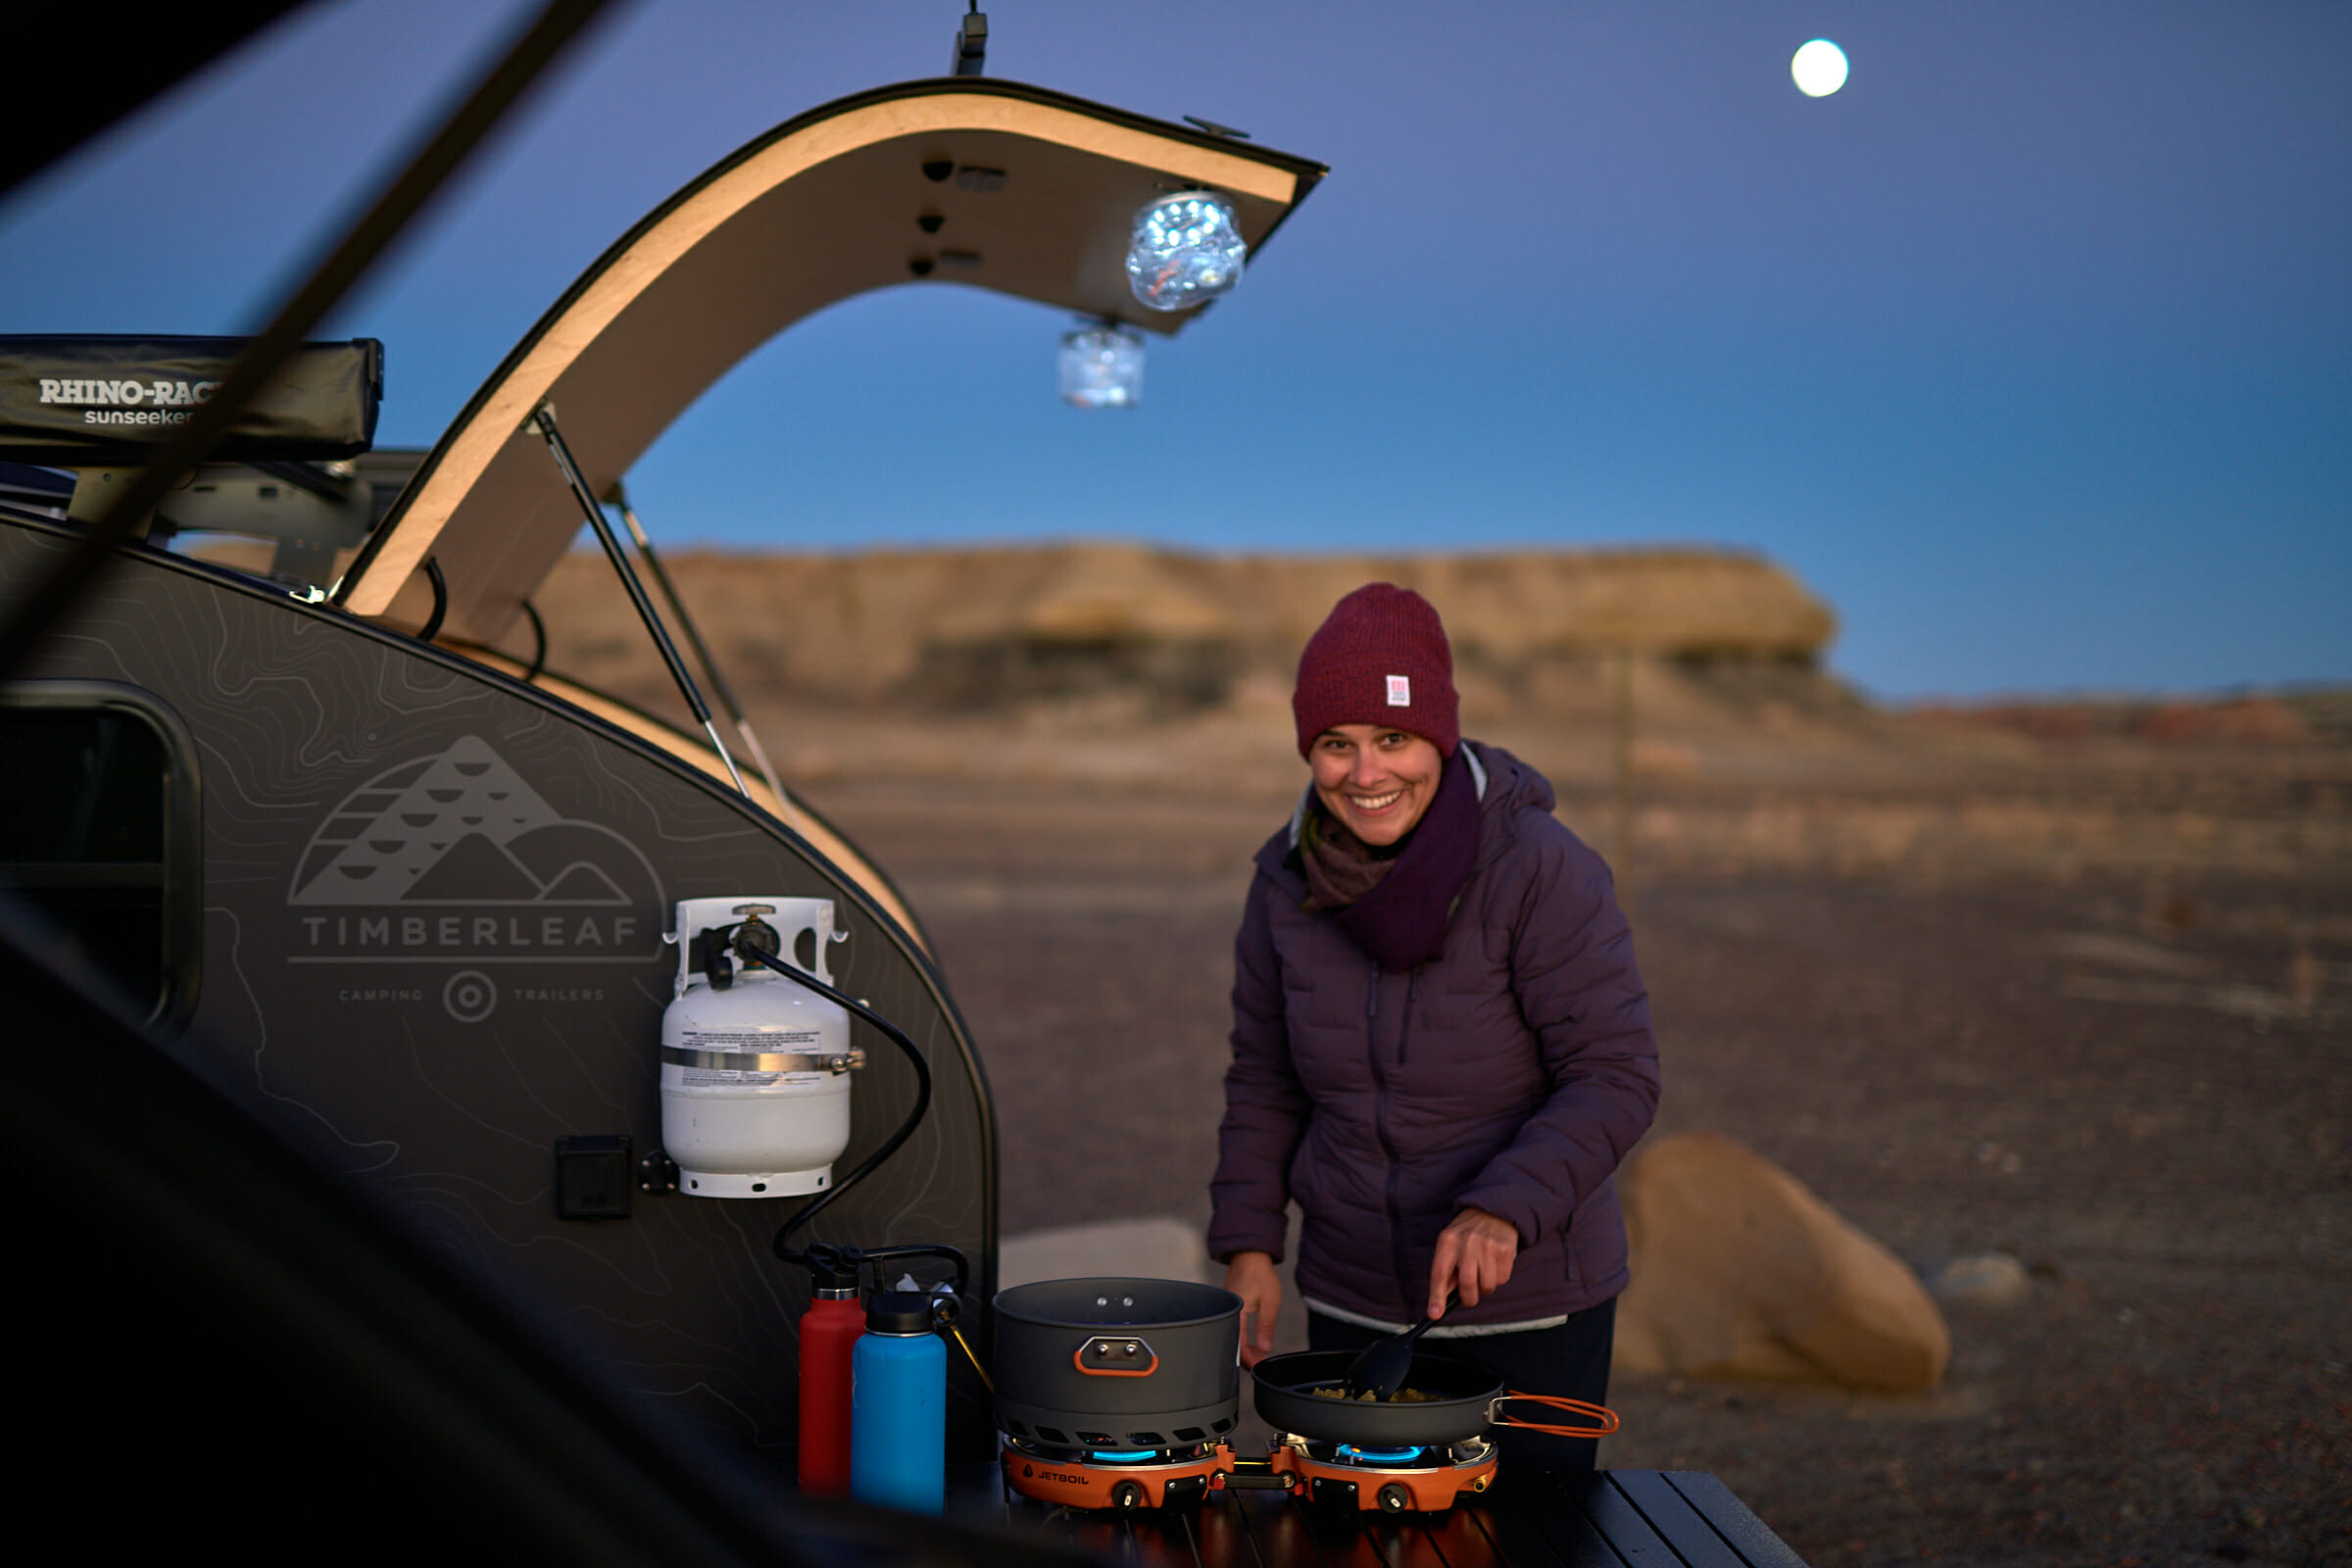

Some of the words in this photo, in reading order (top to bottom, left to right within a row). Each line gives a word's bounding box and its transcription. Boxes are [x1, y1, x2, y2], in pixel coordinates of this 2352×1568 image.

[84, 409, 194, 425] sunseeker
[302, 916, 638, 946] TIMBERLEAF
[338, 989, 424, 1002] CAMPING
[513, 989, 605, 1002] TRAILERS
[1039, 1471, 1090, 1485] JETBOIL
